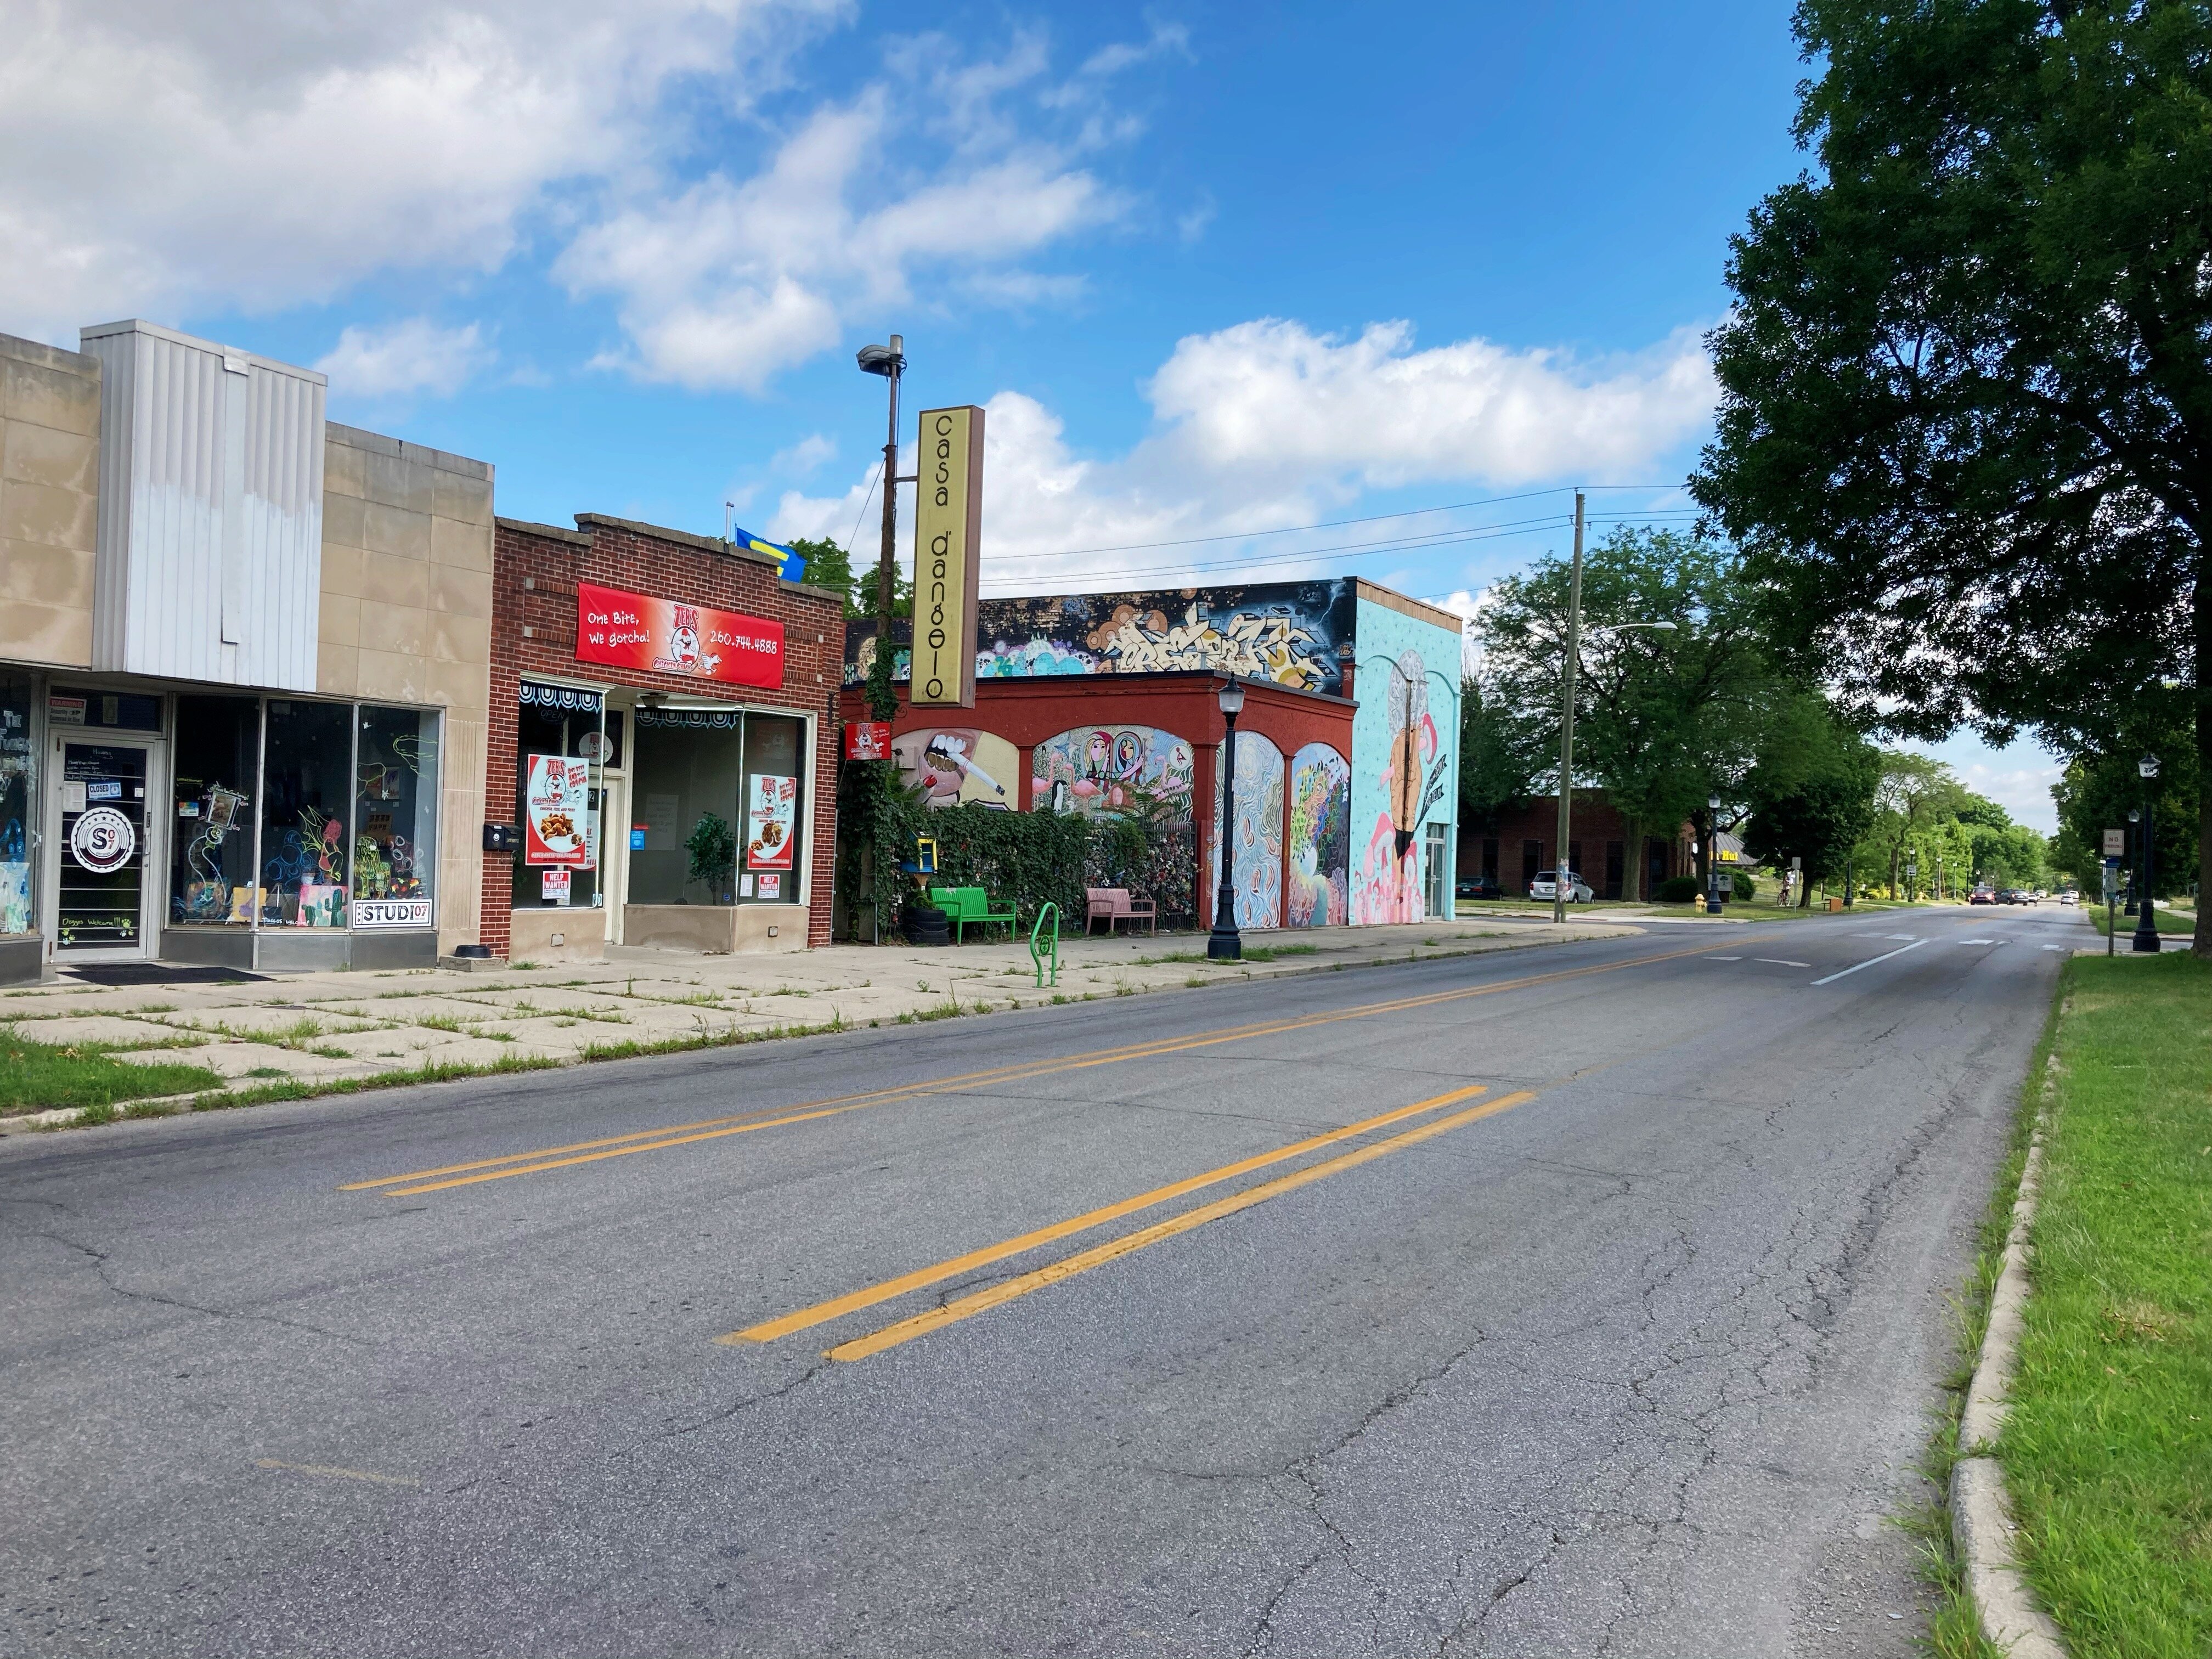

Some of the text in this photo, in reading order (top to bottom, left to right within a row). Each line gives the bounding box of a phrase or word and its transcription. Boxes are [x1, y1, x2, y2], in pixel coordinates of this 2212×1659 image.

[588, 610, 640, 626] One Bite,
[674, 604, 699, 634] ZEB'S
[609, 629, 650, 647] gotcha!
[710, 630, 778, 654] 260.744.4888
[52, 699, 83, 708] WARNING
[540, 709, 565, 719] OPEN
[546, 759, 566, 777] ZEB'S
[89, 785, 109, 793] CLOSED
[1722, 850, 1739, 861] Hut
